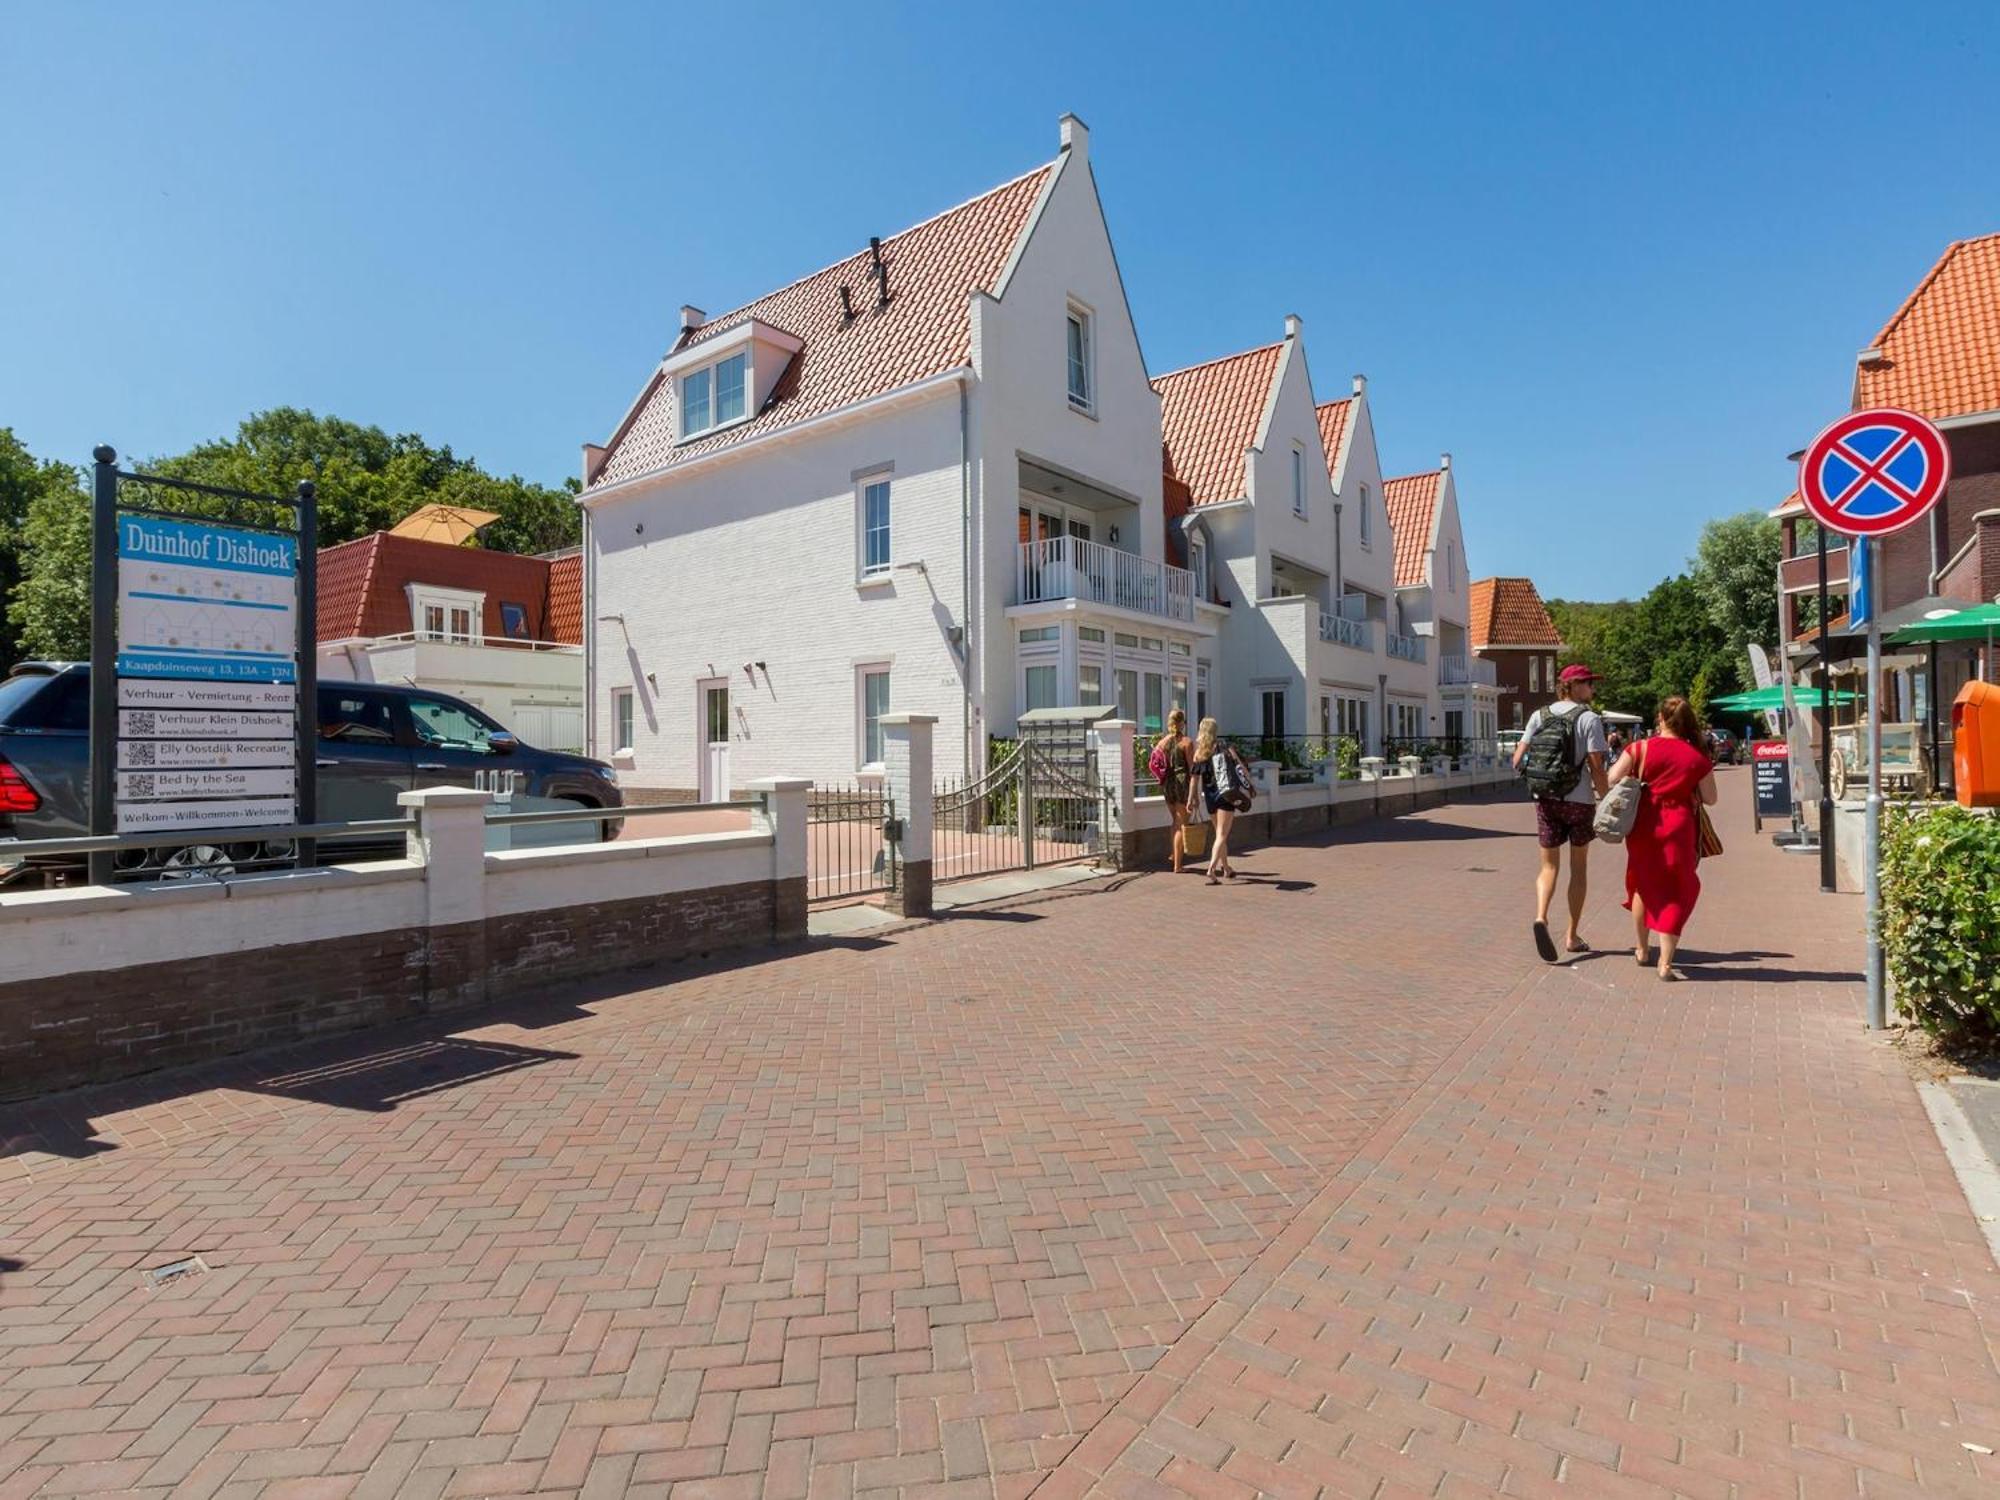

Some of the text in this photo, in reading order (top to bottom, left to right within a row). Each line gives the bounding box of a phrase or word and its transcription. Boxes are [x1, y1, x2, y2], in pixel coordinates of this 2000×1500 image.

[127, 524, 290, 569] Duinhof Dishoek
[125, 660, 215, 675] Kaapduinseweg
[239, 665, 259, 676] 13A
[271, 667, 291, 677] 13N
[125, 688, 175, 700] Verhuur
[188, 690, 253, 704] Vermietung
[159, 714, 283, 726] Verhuur Klein Dishoek
[160, 743, 287, 755] Elly Oostdijk Recreatie
[1757, 744, 1789, 756] Coca-Cola
[159, 773, 246, 786] Bed by the Sea
